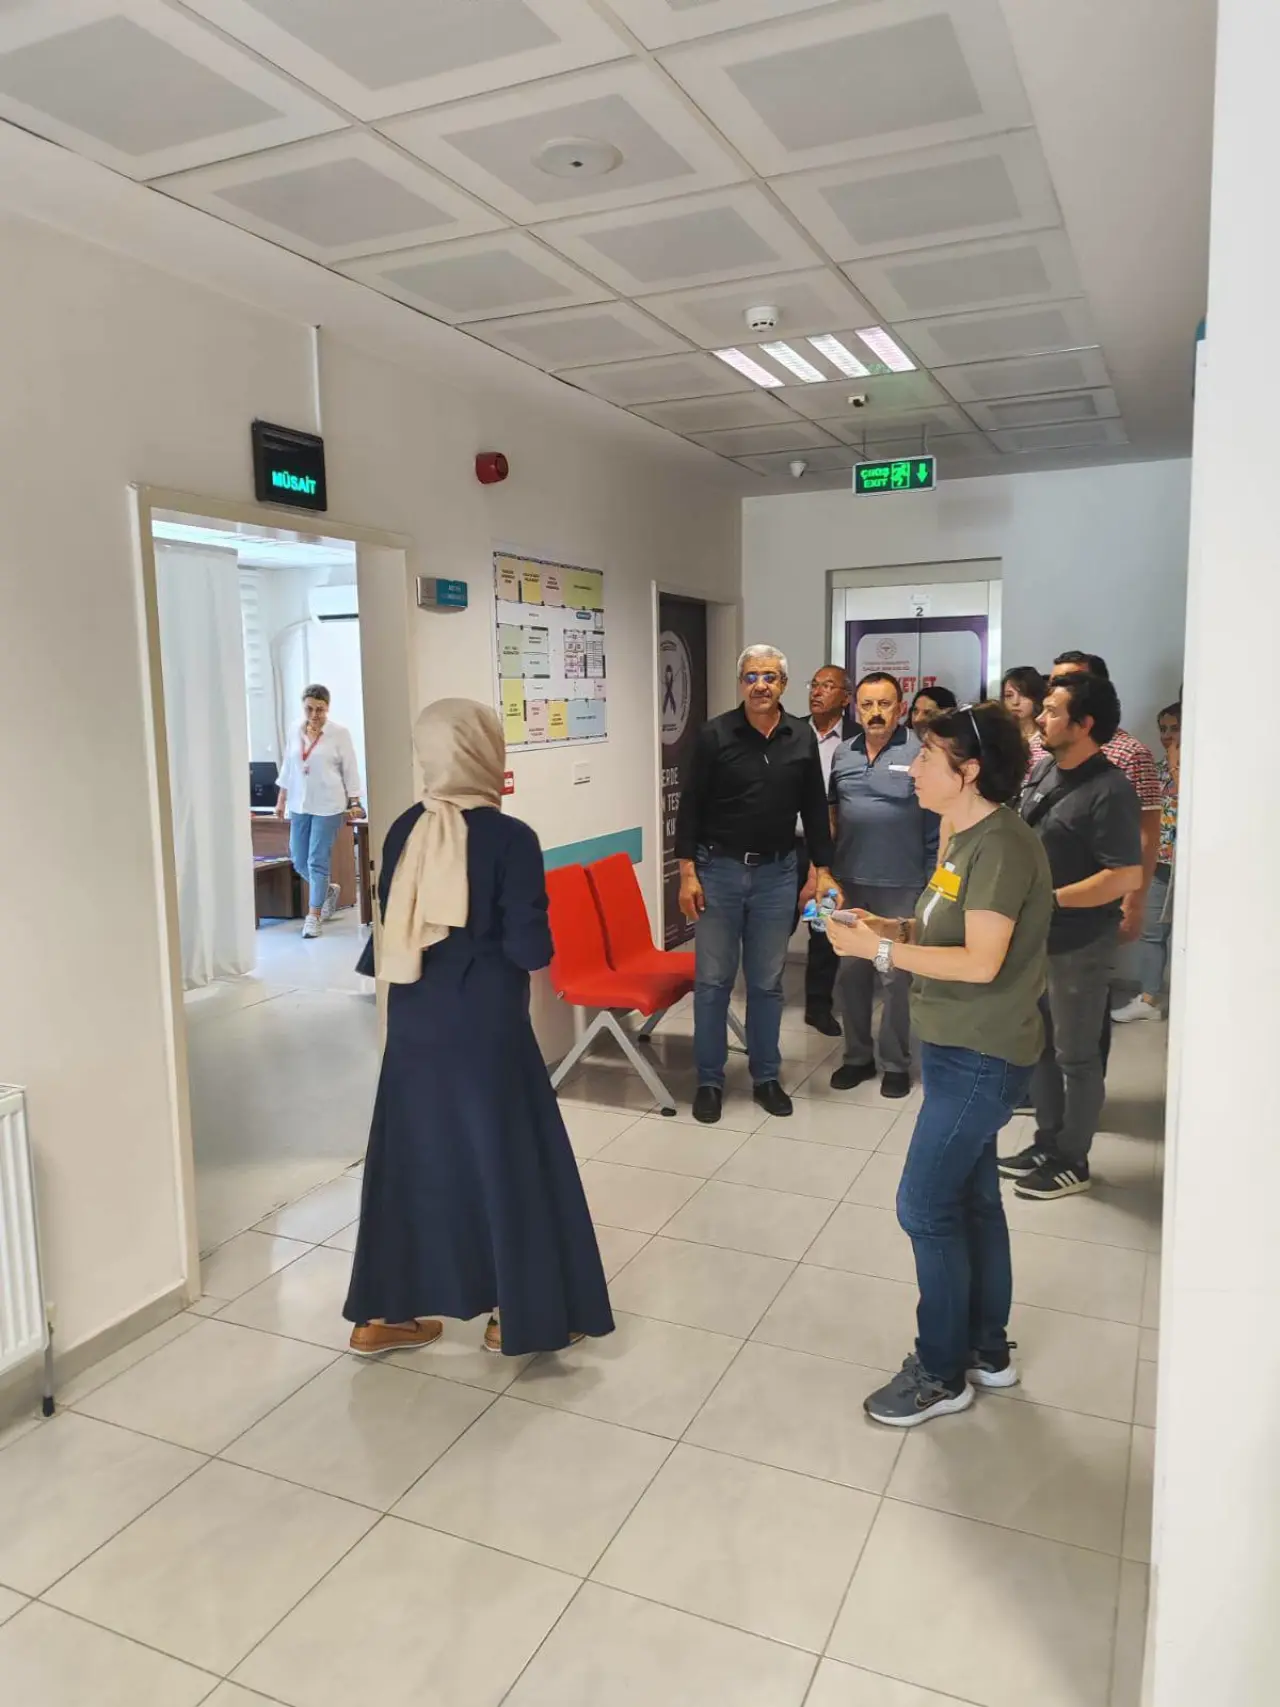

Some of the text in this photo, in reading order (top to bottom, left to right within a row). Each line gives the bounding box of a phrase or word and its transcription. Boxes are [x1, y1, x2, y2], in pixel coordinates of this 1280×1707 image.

[271, 470, 317, 495] MÜSAİT
[863, 478, 888, 488] EXIT
[915, 606, 924, 616] 2
[661, 766, 679, 788] ERDE
